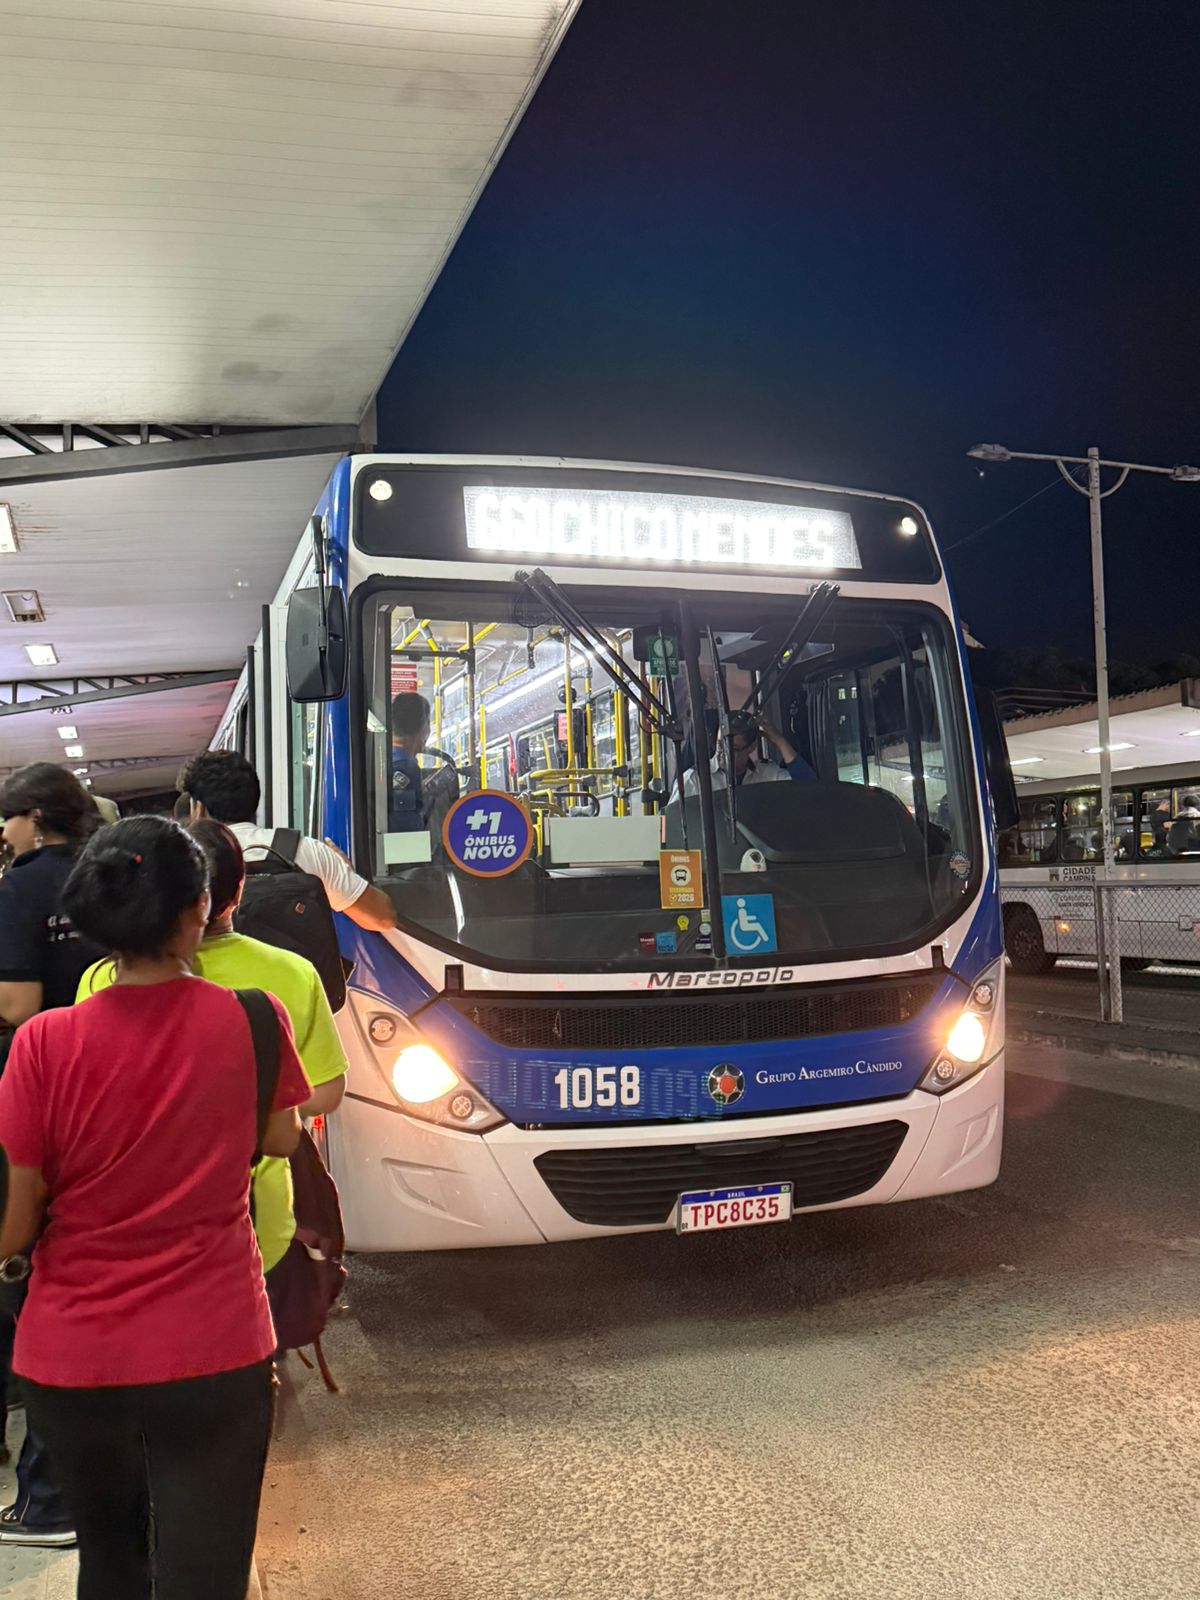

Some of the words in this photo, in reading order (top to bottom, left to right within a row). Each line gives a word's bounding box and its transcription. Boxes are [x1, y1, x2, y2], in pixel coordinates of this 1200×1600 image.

[466, 809, 502, 834] +1
[464, 835, 515, 847] ÔNIBUS
[463, 845, 517, 860] NOVO
[1062, 866, 1096, 876] CIDADE
[648, 966, 794, 988] Marcopolo
[554, 1065, 641, 1109] 1058
[727, 1191, 746, 1199] BRASIL
[690, 1196, 780, 1228] TPC8C35
